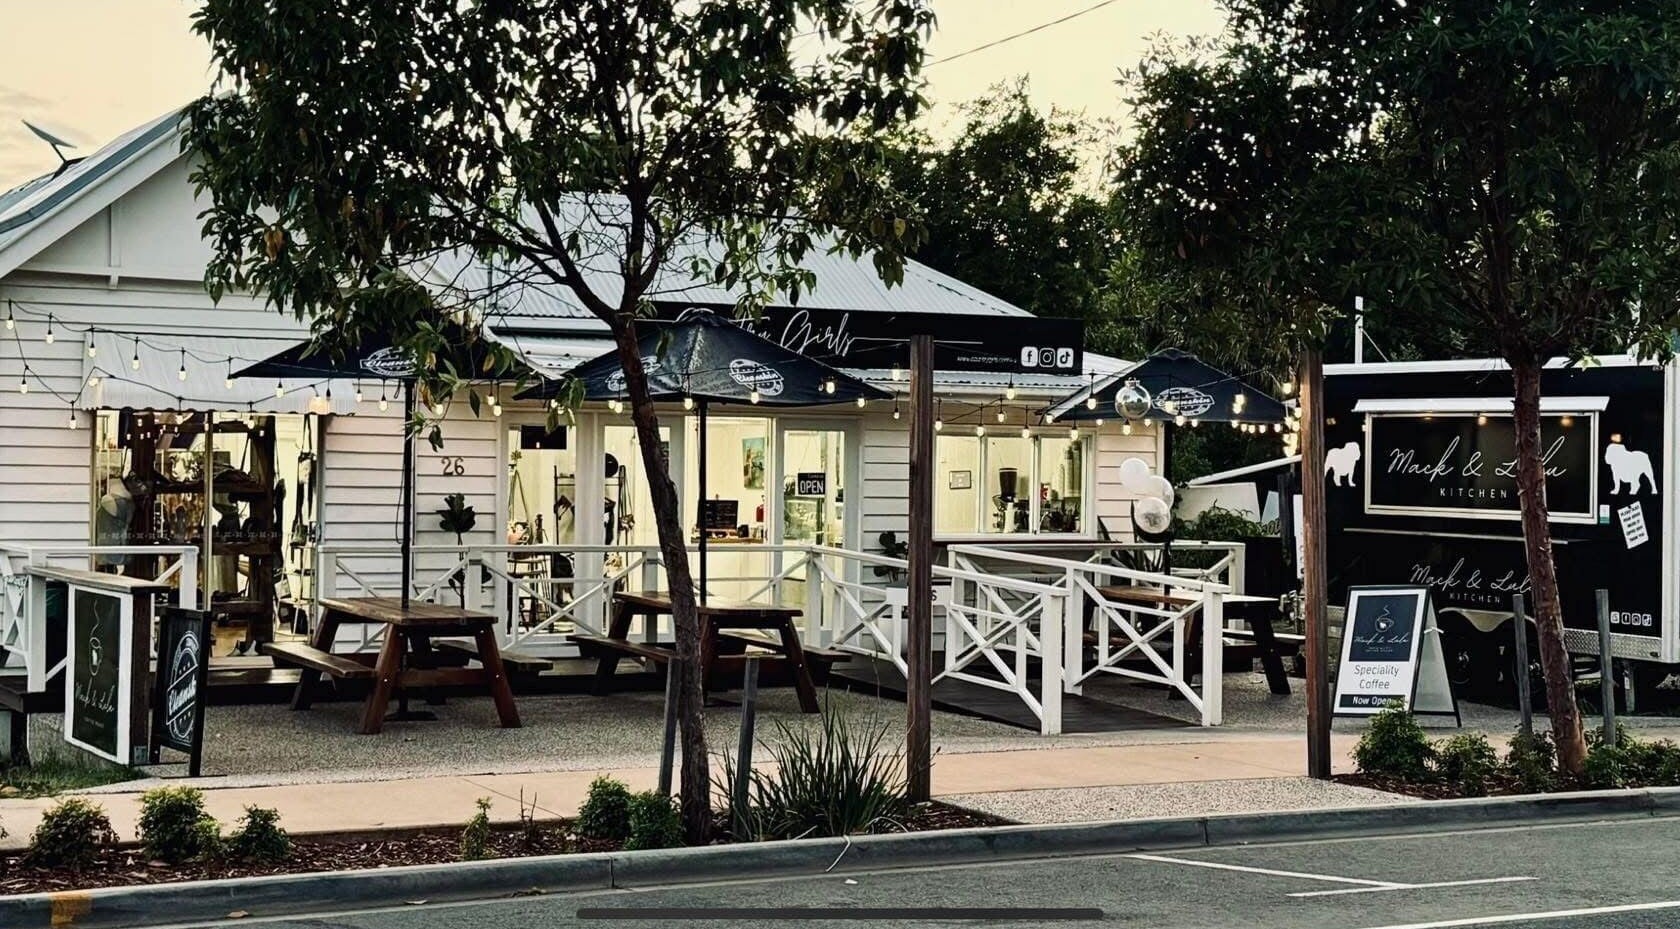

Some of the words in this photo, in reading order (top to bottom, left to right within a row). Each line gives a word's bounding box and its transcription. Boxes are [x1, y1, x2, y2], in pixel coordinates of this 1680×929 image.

[780, 309, 857, 358] Girls
[1388, 436, 1460, 482] Mack
[1462, 451, 1484, 477] &
[1495, 436, 1566, 478] Llu
[441, 456, 465, 477] 26
[800, 480, 824, 493] OPEN
[1440, 488, 1507, 500] KITCHEN
[1410, 557, 1465, 592] Mack
[1466, 570, 1483, 588] &
[1450, 592, 1501, 603] KITCHEN
[1354, 665, 1399, 677] Speciality
[1359, 679, 1390, 689] Coffee
[1353, 696, 1370, 705] Now
[1371, 696, 1392, 706] Open
